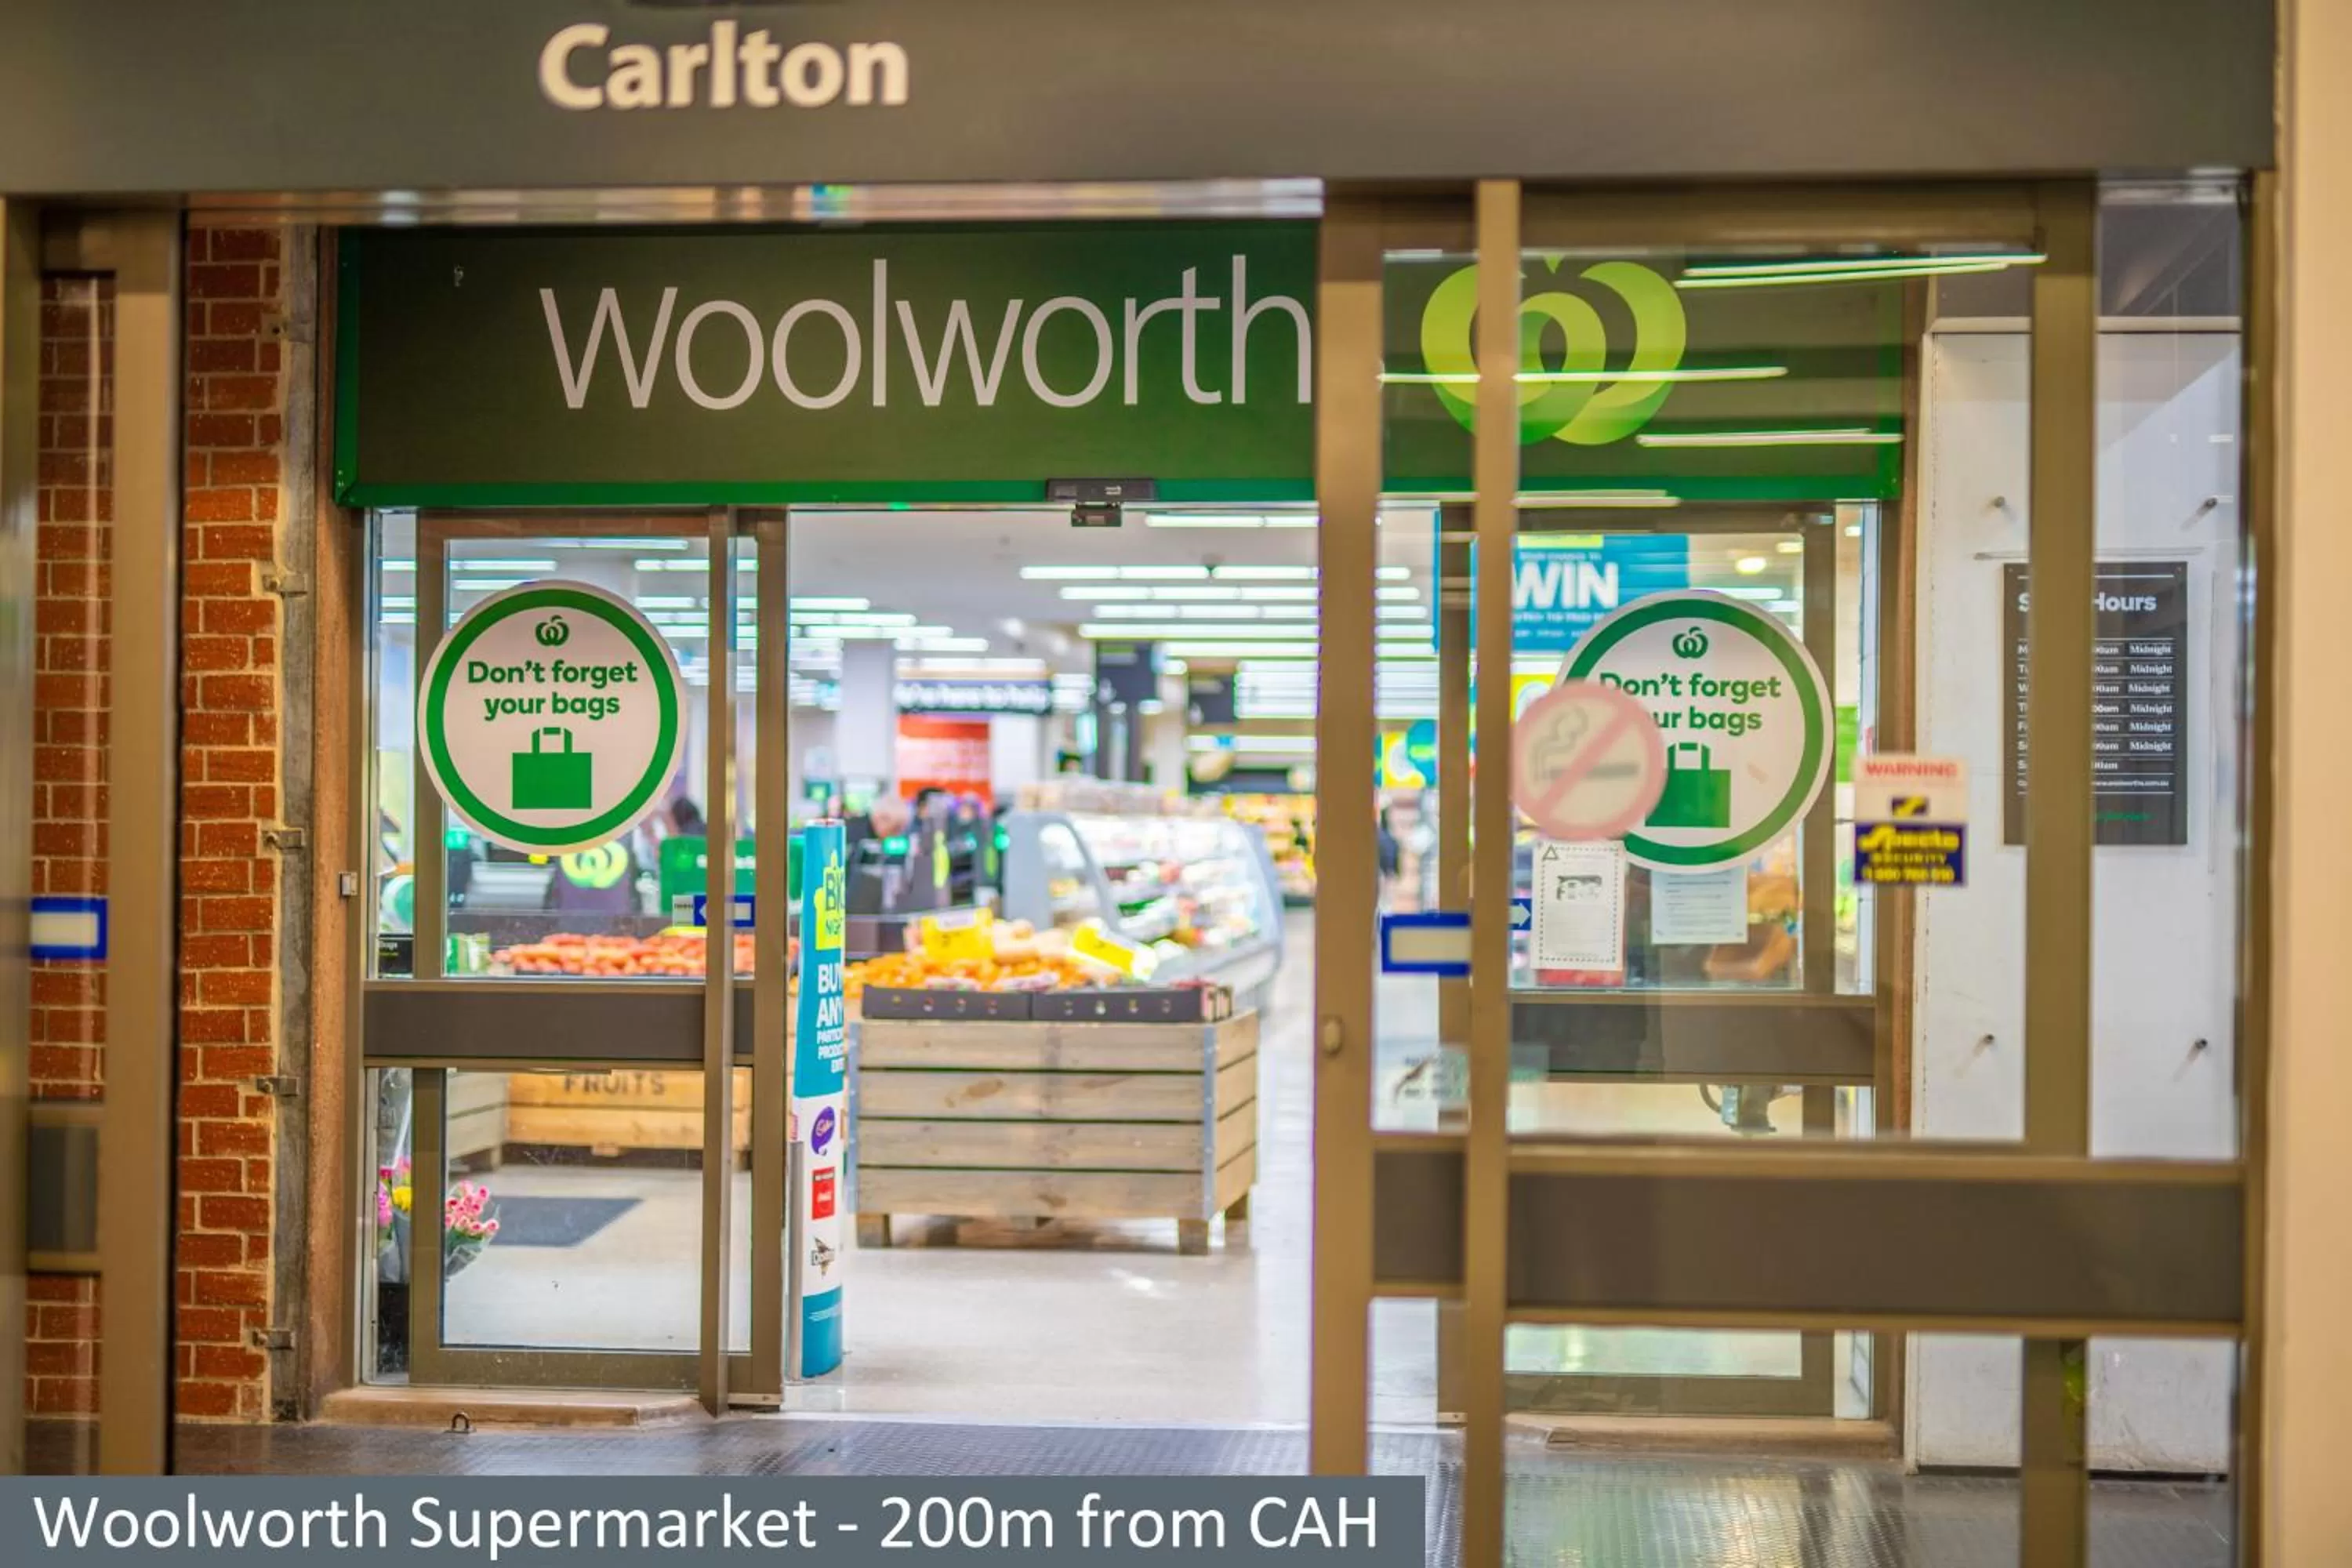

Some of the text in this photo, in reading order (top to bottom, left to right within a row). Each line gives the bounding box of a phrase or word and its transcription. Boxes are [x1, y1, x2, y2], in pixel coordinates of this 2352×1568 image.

[539, 20, 909, 108] Carlton
[539, 254, 1312, 410] Woolworth
[1512, 561, 1620, 609] WIN
[2129, 644, 2172, 655] Midnight
[467, 659, 638, 688] Don't forget
[2130, 663, 2172, 675] Midnight
[1688, 672, 1782, 704] forget
[2128, 683, 2170, 695] Midnight
[484, 691, 620, 721] your bags
[2129, 703, 2172, 714] Midnight
[1653, 705, 1762, 736] ur bags
[2129, 721, 2172, 732] Midnight
[2129, 741, 2172, 752] Midnight
[1865, 763, 1958, 777] WARNING
[562, 1073, 666, 1096] FRUITS
